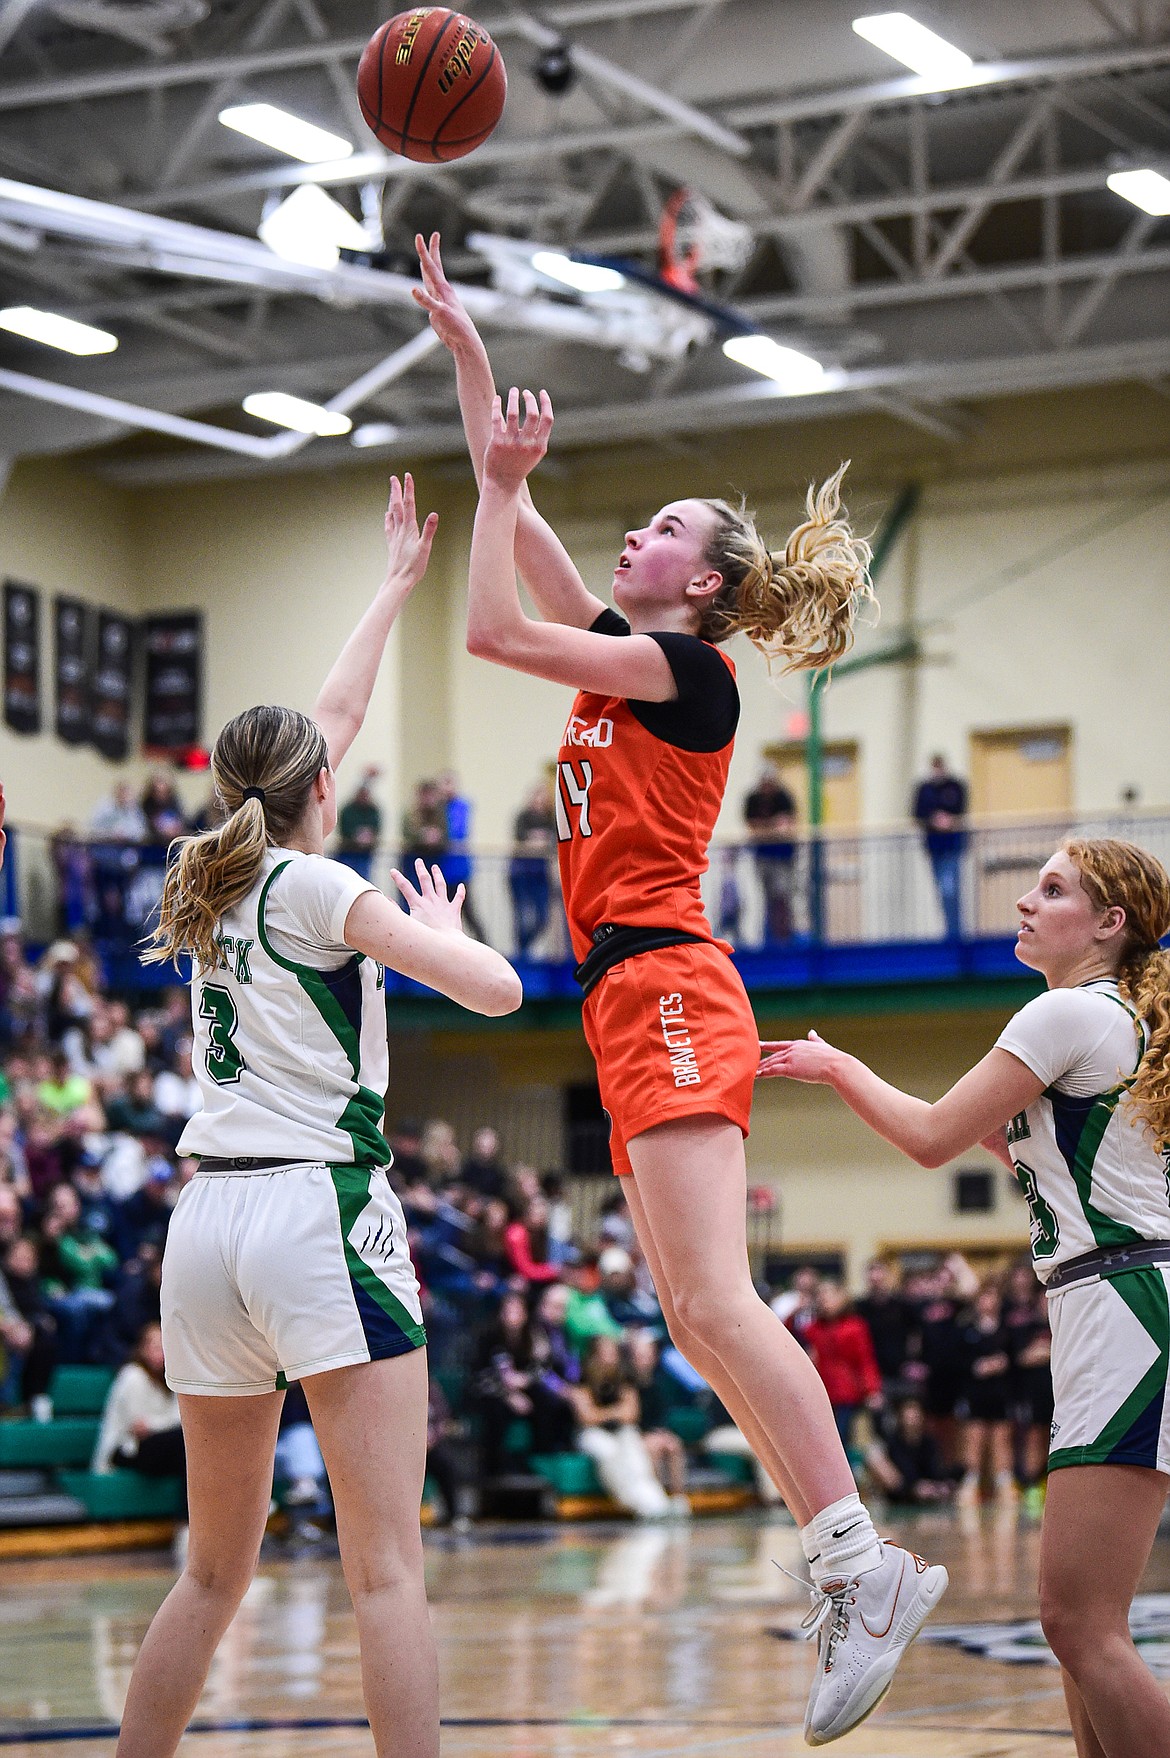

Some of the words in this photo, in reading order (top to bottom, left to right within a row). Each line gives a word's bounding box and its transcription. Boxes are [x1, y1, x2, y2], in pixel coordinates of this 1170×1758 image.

[555, 760, 593, 842] 14
[199, 981, 246, 1086] 3
[659, 992, 701, 1088] BRAVETTES
